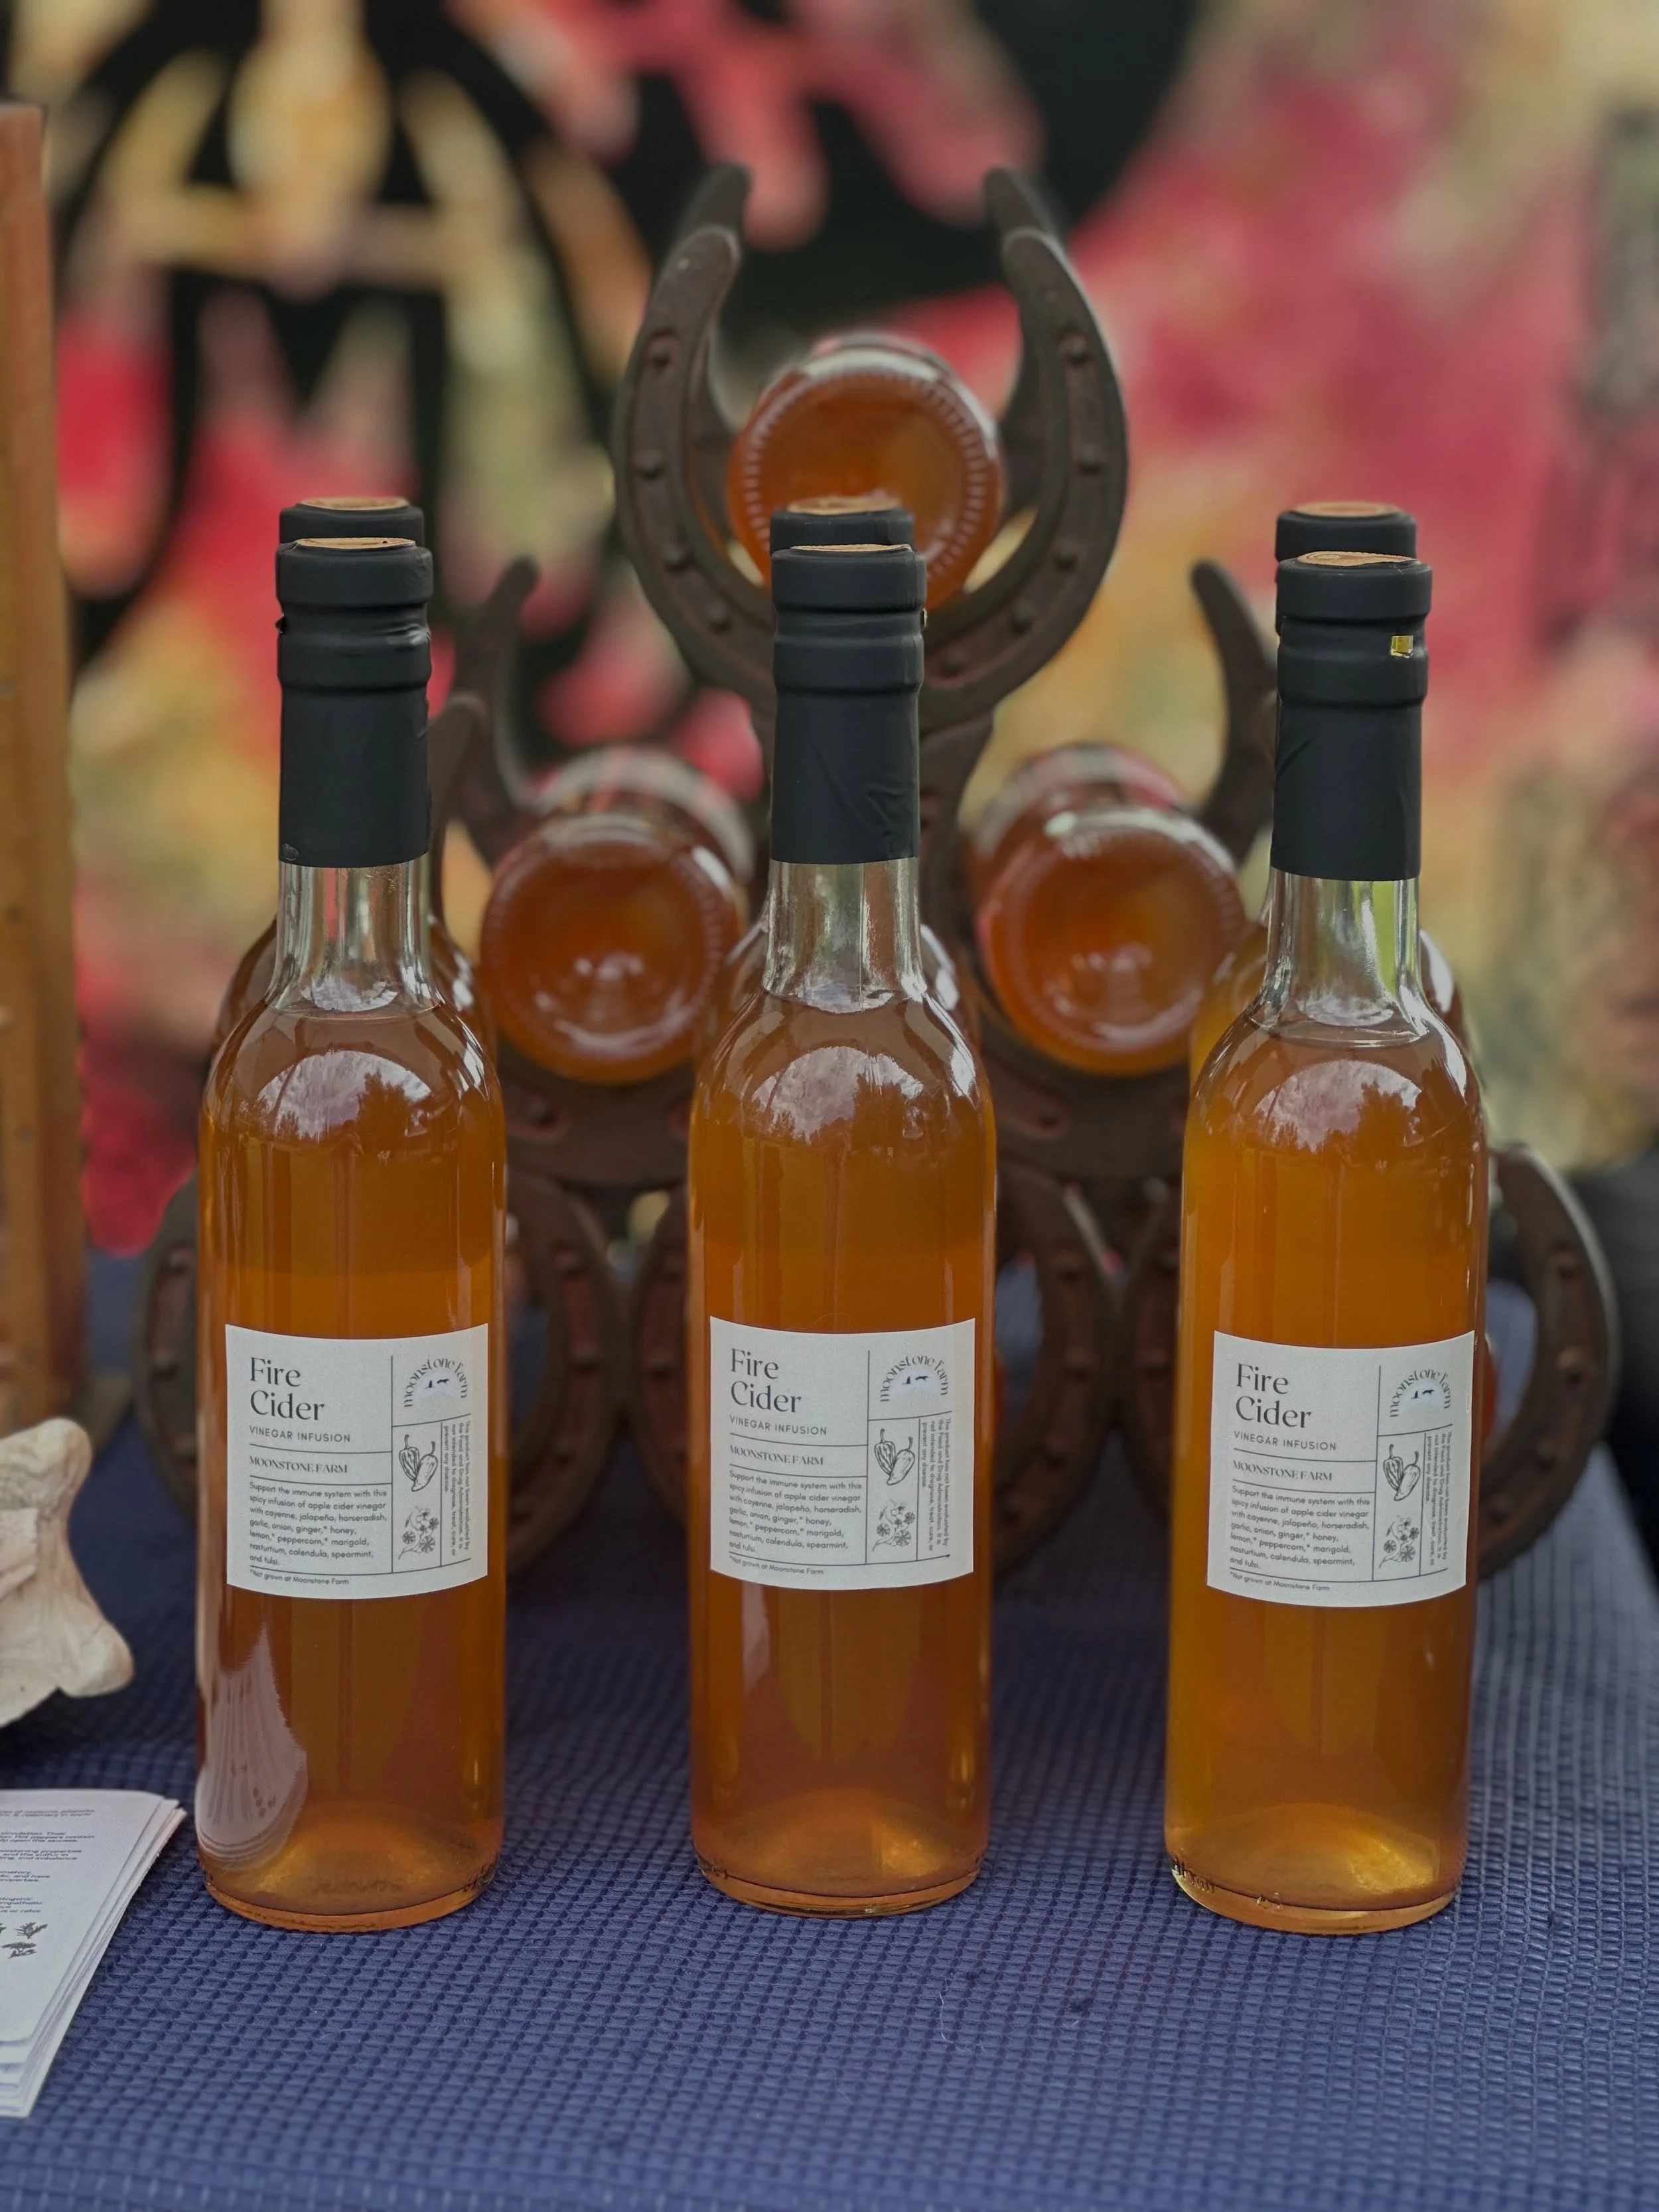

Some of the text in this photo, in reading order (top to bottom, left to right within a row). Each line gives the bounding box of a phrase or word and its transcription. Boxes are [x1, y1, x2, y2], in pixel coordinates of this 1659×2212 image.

[250, 1357, 301, 1388] Fire
[731, 1348, 778, 1380] Fire
[1236, 1363, 1289, 1394] Fire
[250, 1390, 325, 1421] Cider
[731, 1381, 802, 1413] Cider
[1236, 1396, 1311, 1428] Cider
[250, 1426, 350, 1442] VINEGAR INFUSION
[730, 1414, 828, 1435] VINEGAR INFUSION
[1234, 1430, 1336, 1451] VINEGAR INFUSION
[250, 1455, 348, 1473] MOONSTONE FARM
[730, 1445, 824, 1465] MOONSTONE FARM
[730, 1470, 754, 1481] Support
[757, 1475, 766, 1484] the
[770, 1477, 798, 1487] immune
[801, 1481, 826, 1490] system
[1233, 1460, 1333, 1481] MOONSTONE FARM
[250, 1482, 275, 1493] Support
[325, 1490, 351, 1499] system
[730, 1483, 745, 1493] spicy
[746, 1486, 772, 1497] infusion
[1232, 1485, 1259, 1497] Support
[1276, 1495, 1306, 1504] immune
[250, 1495, 266, 1505] spicy
[268, 1497, 295, 1507] infusion
[298, 1499, 305, 1508] of
[308, 1501, 330, 1511] apple
[356, 1503, 386, 1511] vinegar
[1232, 1499, 1248, 1509] spicy
[1251, 1503, 1278, 1512] infusion
[339, 1513, 387, 1522] horseradish,
[1322, 1520, 1369, 1530] horseradish,
